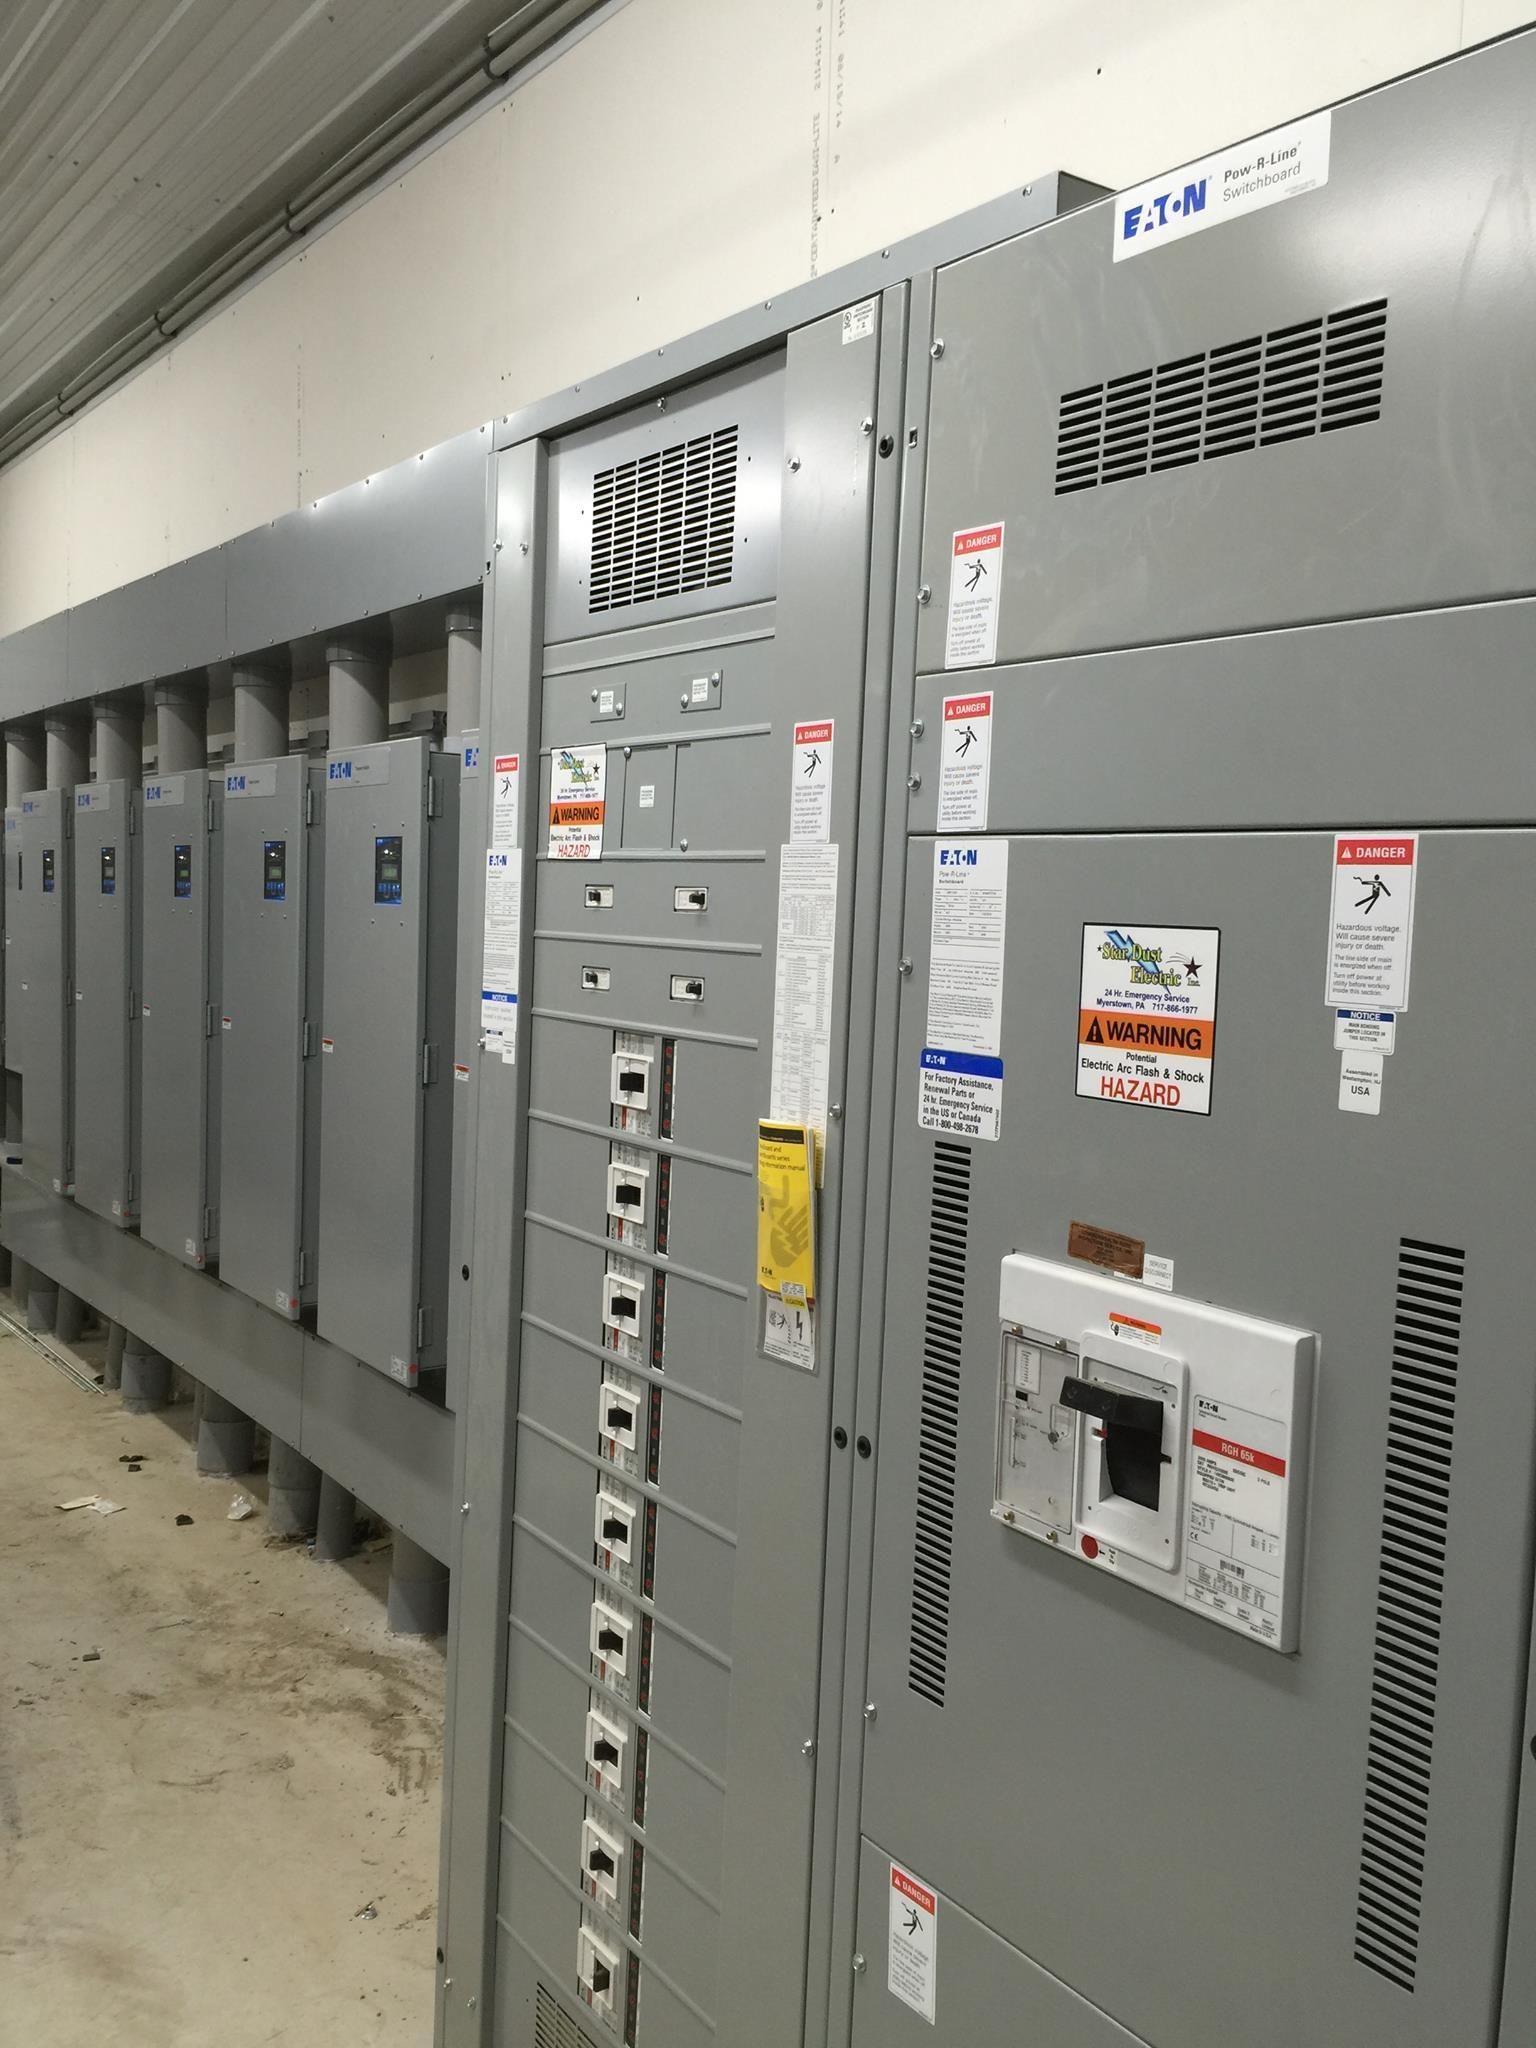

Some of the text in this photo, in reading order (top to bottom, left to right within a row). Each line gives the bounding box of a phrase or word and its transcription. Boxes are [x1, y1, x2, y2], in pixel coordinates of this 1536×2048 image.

[1223, 161, 1301, 202] Switchboard
[1123, 178, 1207, 240] EATON
[966, 534, 996, 548] DANGER
[956, 703, 986, 714] DANGER
[804, 730, 828, 739] DANGER
[330, 762, 351, 779] EATON
[560, 807, 599, 820] WARNING
[557, 844, 590, 857] HAZARD
[941, 850, 977, 865] EATON
[1356, 847, 1406, 858] DANGER
[489, 855, 507, 866] EATON
[1336, 923, 1372, 931] Hazardous
[1102, 942, 1162, 962] Star Dust
[1130, 966, 1182, 986] Electric
[1105, 989, 1190, 1003] 24 Hr. Emergency Service
[1097, 998, 1198, 1014] Myerstown, PA 717-866-1977
[1350, 1011, 1381, 1021] NOTICE
[1107, 1020, 1202, 1050] WARNING
[1126, 1053, 1157, 1064] Potential
[1082, 1058, 1204, 1083] Electric Arc Flash & Shock
[925, 1072, 994, 1091] For Factory Assistance,
[924, 1083, 950, 1095] Renewal
[951, 1087, 967, 1098] Parts
[1101, 1076, 1180, 1107] HAZARD
[1351, 1085, 1370, 1096] USA
[939, 1097, 970, 1111] Emergency
[971, 1102, 993, 1113] Service
[922, 1116, 935, 1126] Call
[923, 1106, 929, 1114] in
[930, 1107, 940, 1115] the
[940, 1108, 950, 1117] US
[958, 1111, 982, 1123] Canada
[1222, 1442, 1254, 1462] RGH 65k
[902, 1882, 930, 1907] DANGER
